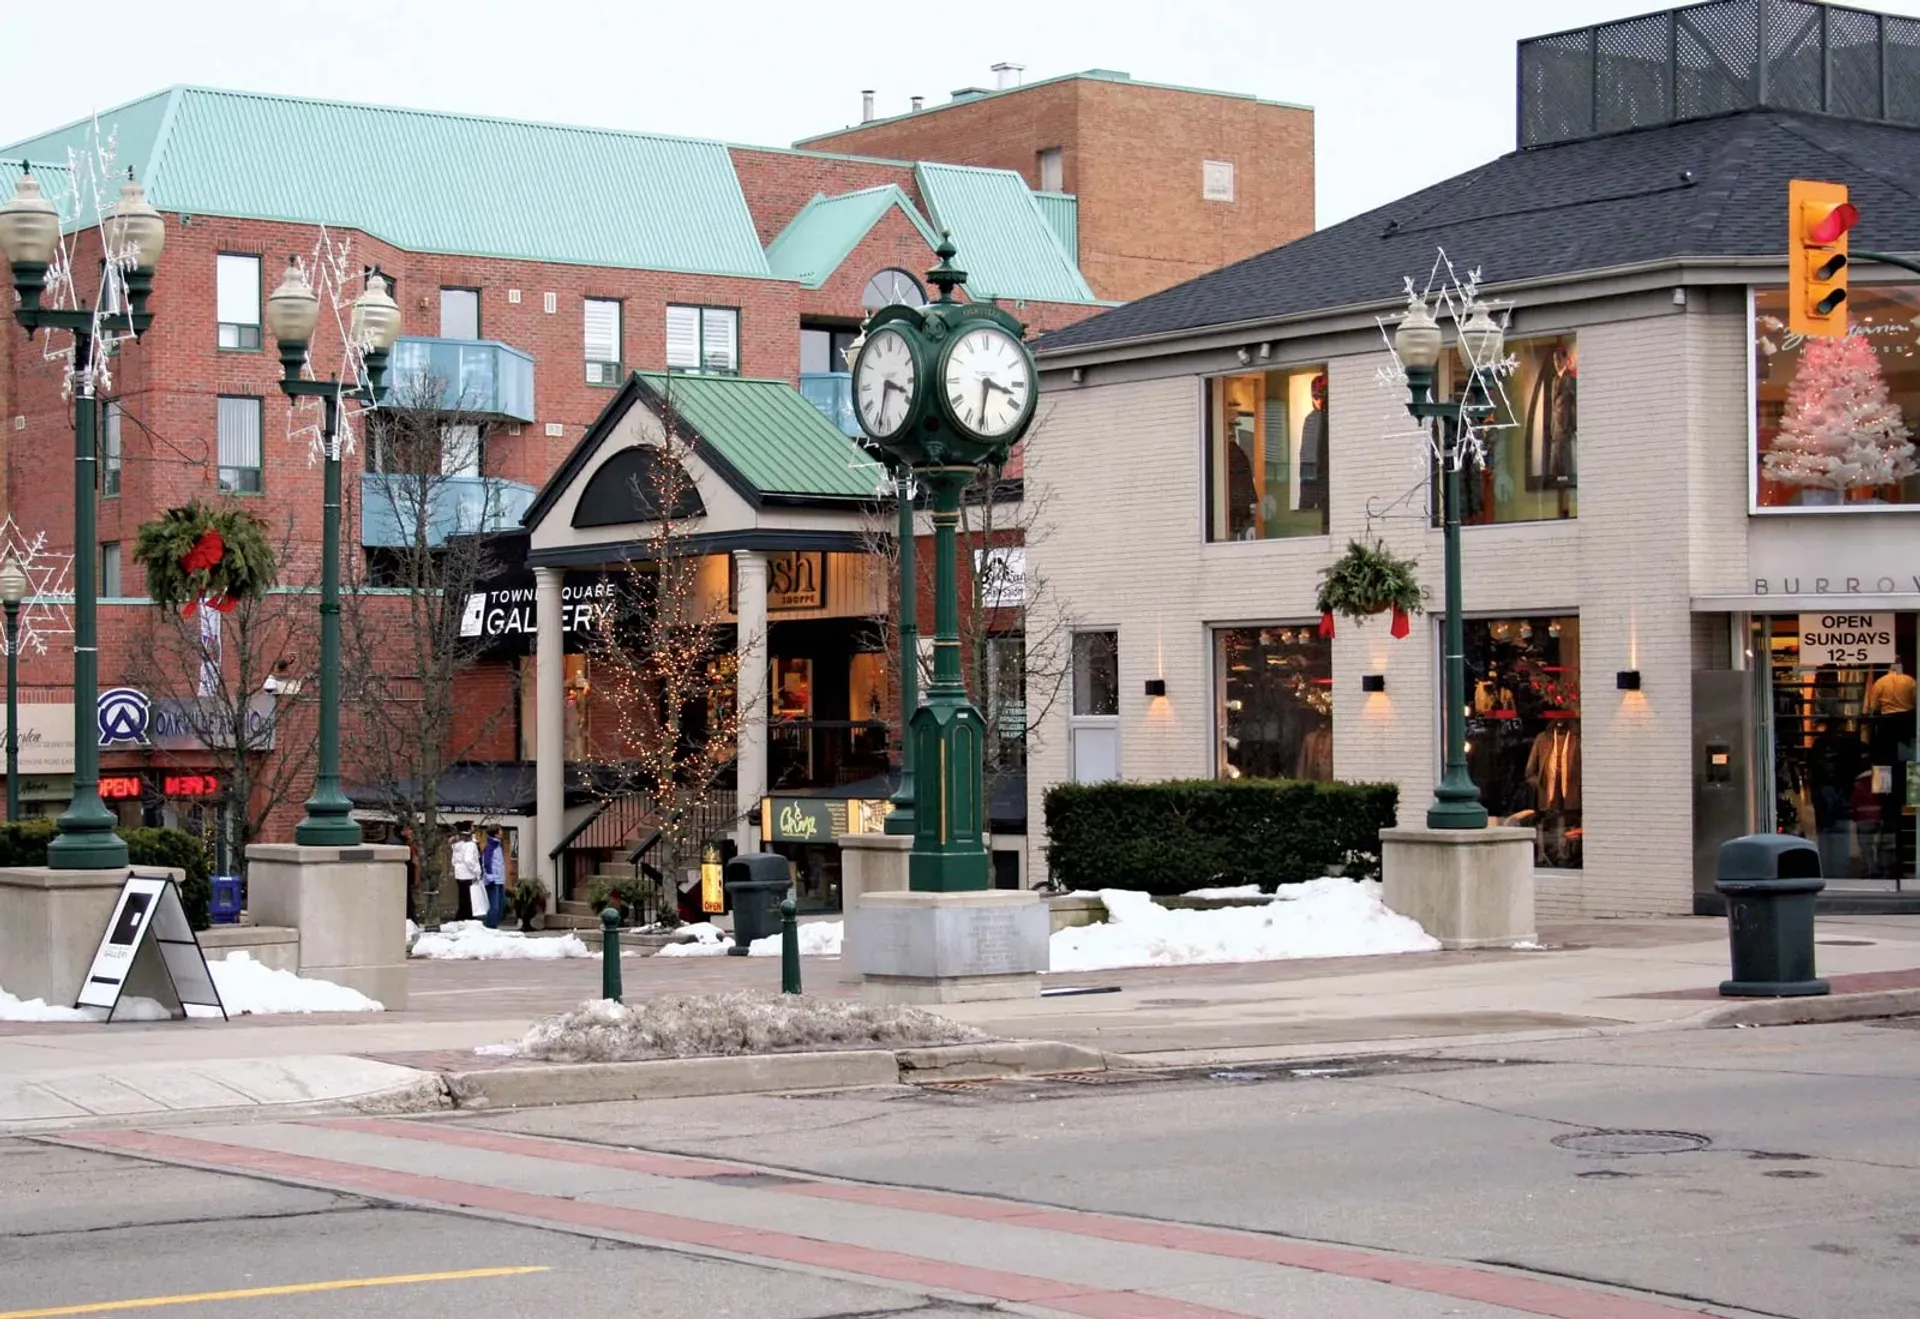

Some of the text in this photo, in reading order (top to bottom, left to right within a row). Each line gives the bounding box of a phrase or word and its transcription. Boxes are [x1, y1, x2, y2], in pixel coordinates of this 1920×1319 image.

[561, 583, 616, 599] QUARE
[487, 602, 612, 635] GALERY
[1821, 615, 1873, 629] OPEN
[1804, 632, 1891, 646] SUNDAYS
[1827, 649, 1868, 662] 12-5
[218, 710, 263, 735] AUIO
